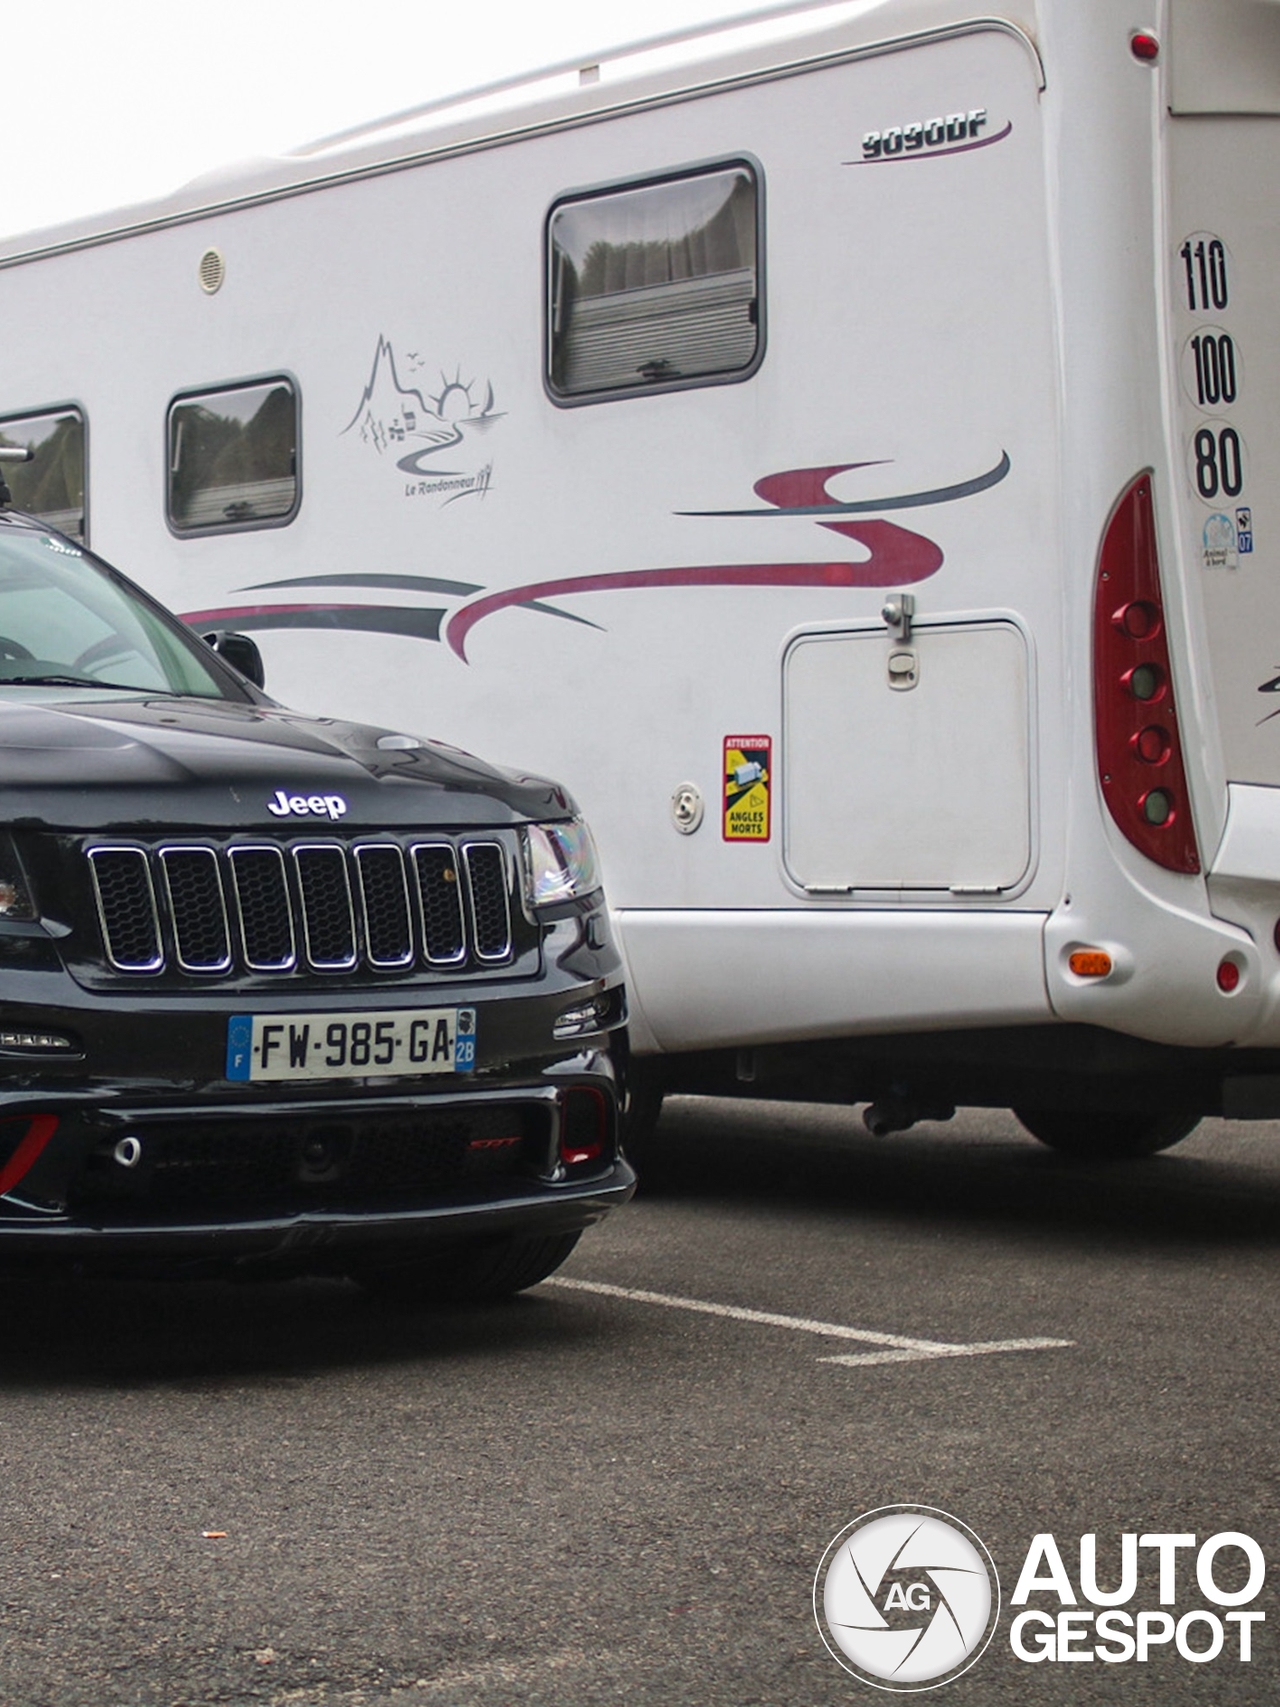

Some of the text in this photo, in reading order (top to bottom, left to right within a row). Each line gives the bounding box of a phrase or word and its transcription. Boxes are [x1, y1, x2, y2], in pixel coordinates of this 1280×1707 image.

[1181, 240, 1228, 310] 110
[1191, 334, 1236, 405] 100
[1194, 427, 1242, 498] 80
[405, 477, 475, 497] Le Randonneur
[1239, 533, 1251, 551] 07
[1203, 547, 1228, 558] Animal
[726, 738, 768, 748] ATTENTION
[267, 791, 347, 820] Jeep
[730, 812, 764, 823] ANGLES
[731, 823, 762, 834] MORTS
[261, 1019, 450, 1068] FW-985-GA
[456, 1041, 475, 1062] 2B
[234, 1054, 243, 1067] F
